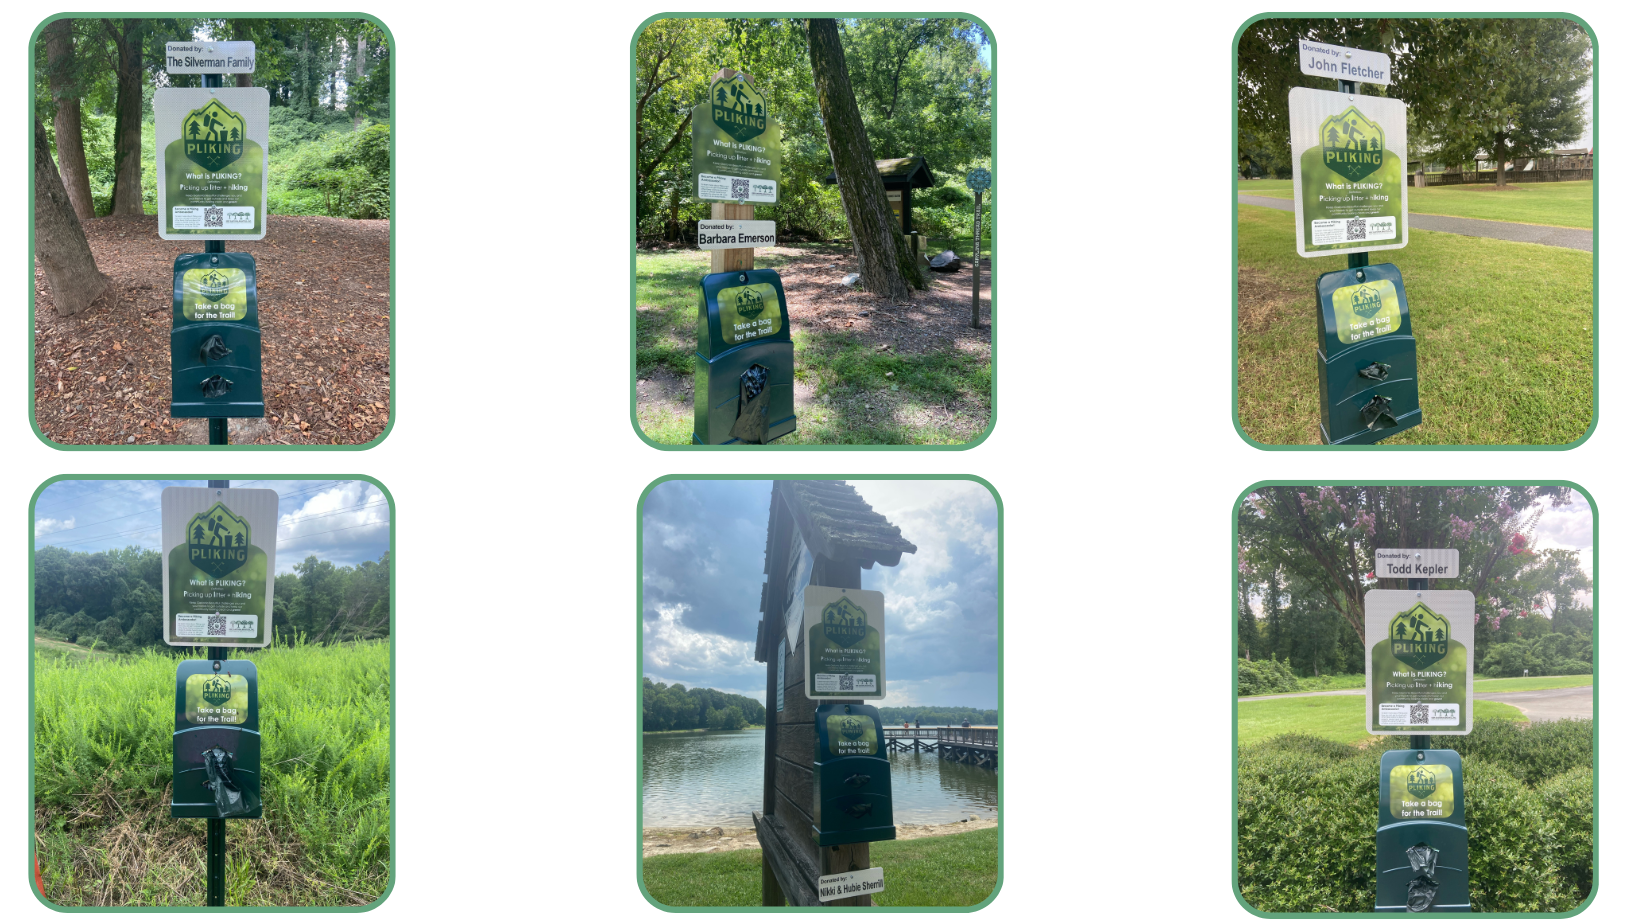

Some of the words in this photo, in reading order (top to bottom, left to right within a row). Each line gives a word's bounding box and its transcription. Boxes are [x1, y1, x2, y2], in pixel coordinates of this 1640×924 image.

[1302, 44, 1330, 55] Donated
[1331, 48, 1341, 58] by:
[167, 56, 183, 67] The
[184, 56, 225, 67] Silverman
[228, 56, 254, 70] Family
[1308, 57, 1338, 72] John
[1341, 62, 1385, 79] Fletcher
[715, 109, 764, 129] PLIKING
[188, 144, 240, 155] PLIKING
[713, 139, 731, 148] What
[738, 144, 766, 153] PLIKING?
[707, 150, 728, 160] Picking
[754, 157, 771, 166] hiking
[1326, 151, 1381, 165] PLIKING
[1320, 195, 1341, 203] Picking
[699, 233, 736, 244] Barbara
[738, 233, 775, 243] Emerson
[738, 304, 764, 312] PLIKING
[1354, 302, 1380, 312] PLIKING
[733, 322, 750, 331] Take
[758, 326, 772, 335] Trail!
[1350, 322, 1368, 331] Take
[1376, 324, 1392, 334] Trail!
[192, 548, 245, 561] PLIKING
[1387, 564, 1411, 574] Todd
[1415, 564, 1448, 576] Kepler
[184, 591, 203, 599] Picking
[826, 626, 864, 636] PLIKING
[1394, 643, 1445, 654] PLIKING
[222, 707, 237, 715] bag
[820, 886, 835, 897] Nikki
[837, 885, 842, 894] &
[844, 883, 861, 893] Hubie
[862, 879, 883, 890] Sherrill
